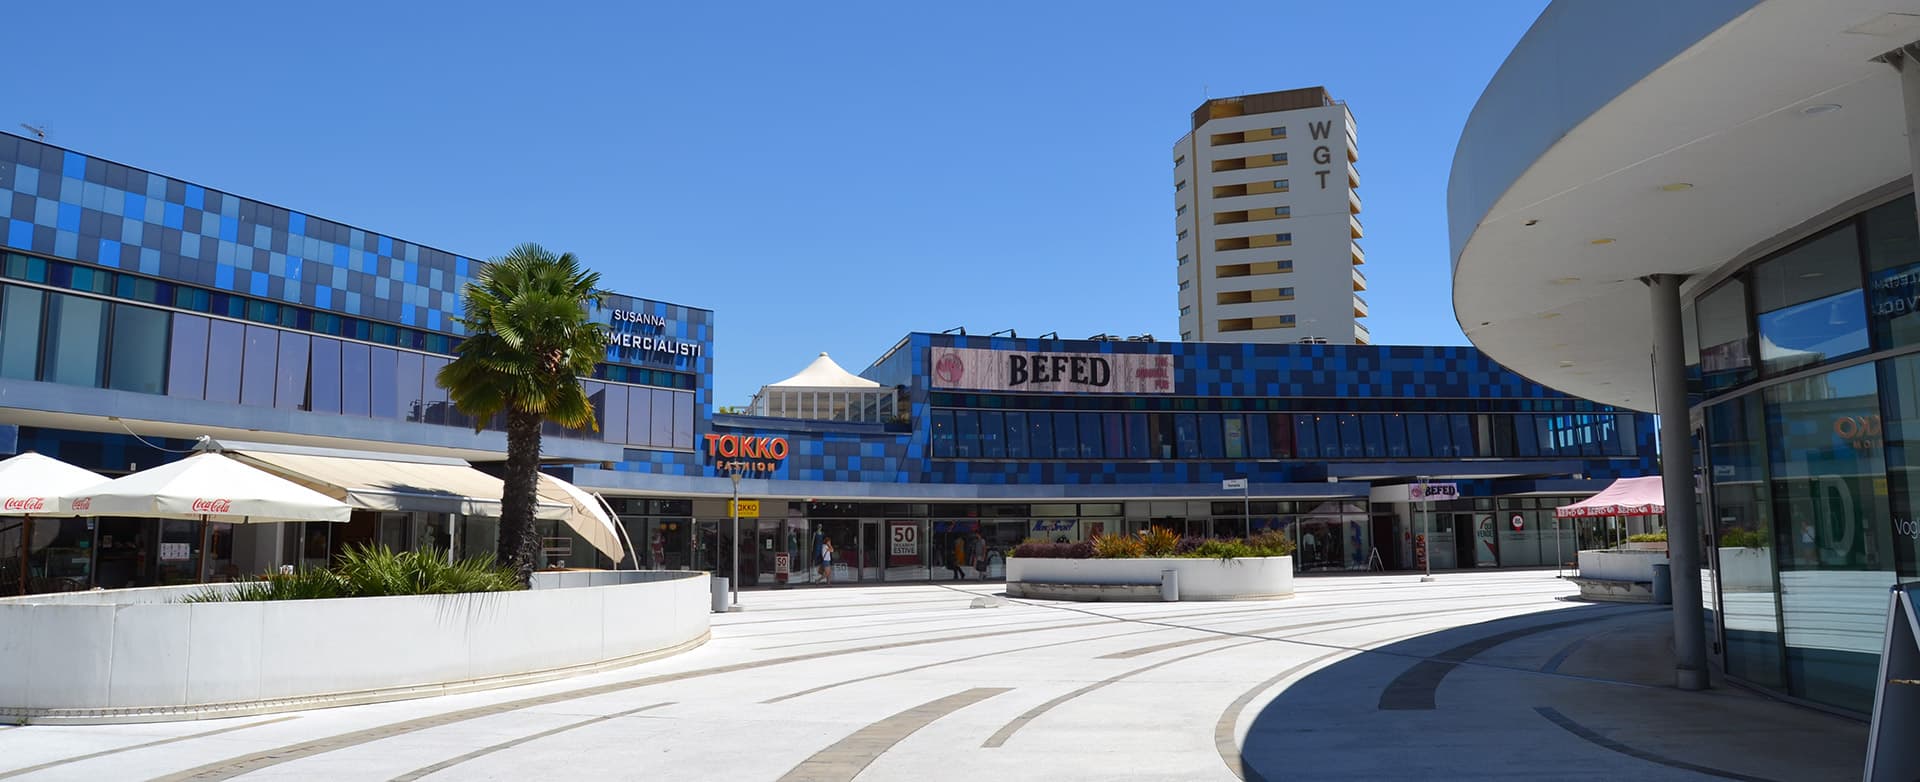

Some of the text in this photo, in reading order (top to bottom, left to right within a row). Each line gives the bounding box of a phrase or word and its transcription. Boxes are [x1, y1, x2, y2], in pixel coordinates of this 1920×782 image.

[1309, 120, 1331, 189] WGT
[614, 309, 666, 327] SUSANNA
[1009, 354, 1111, 387] BEFED
[716, 461, 776, 472] FASHION
[1425, 485, 1456, 497] BEFED
[894, 527, 915, 542] 50
[777, 557, 787, 567] 50
